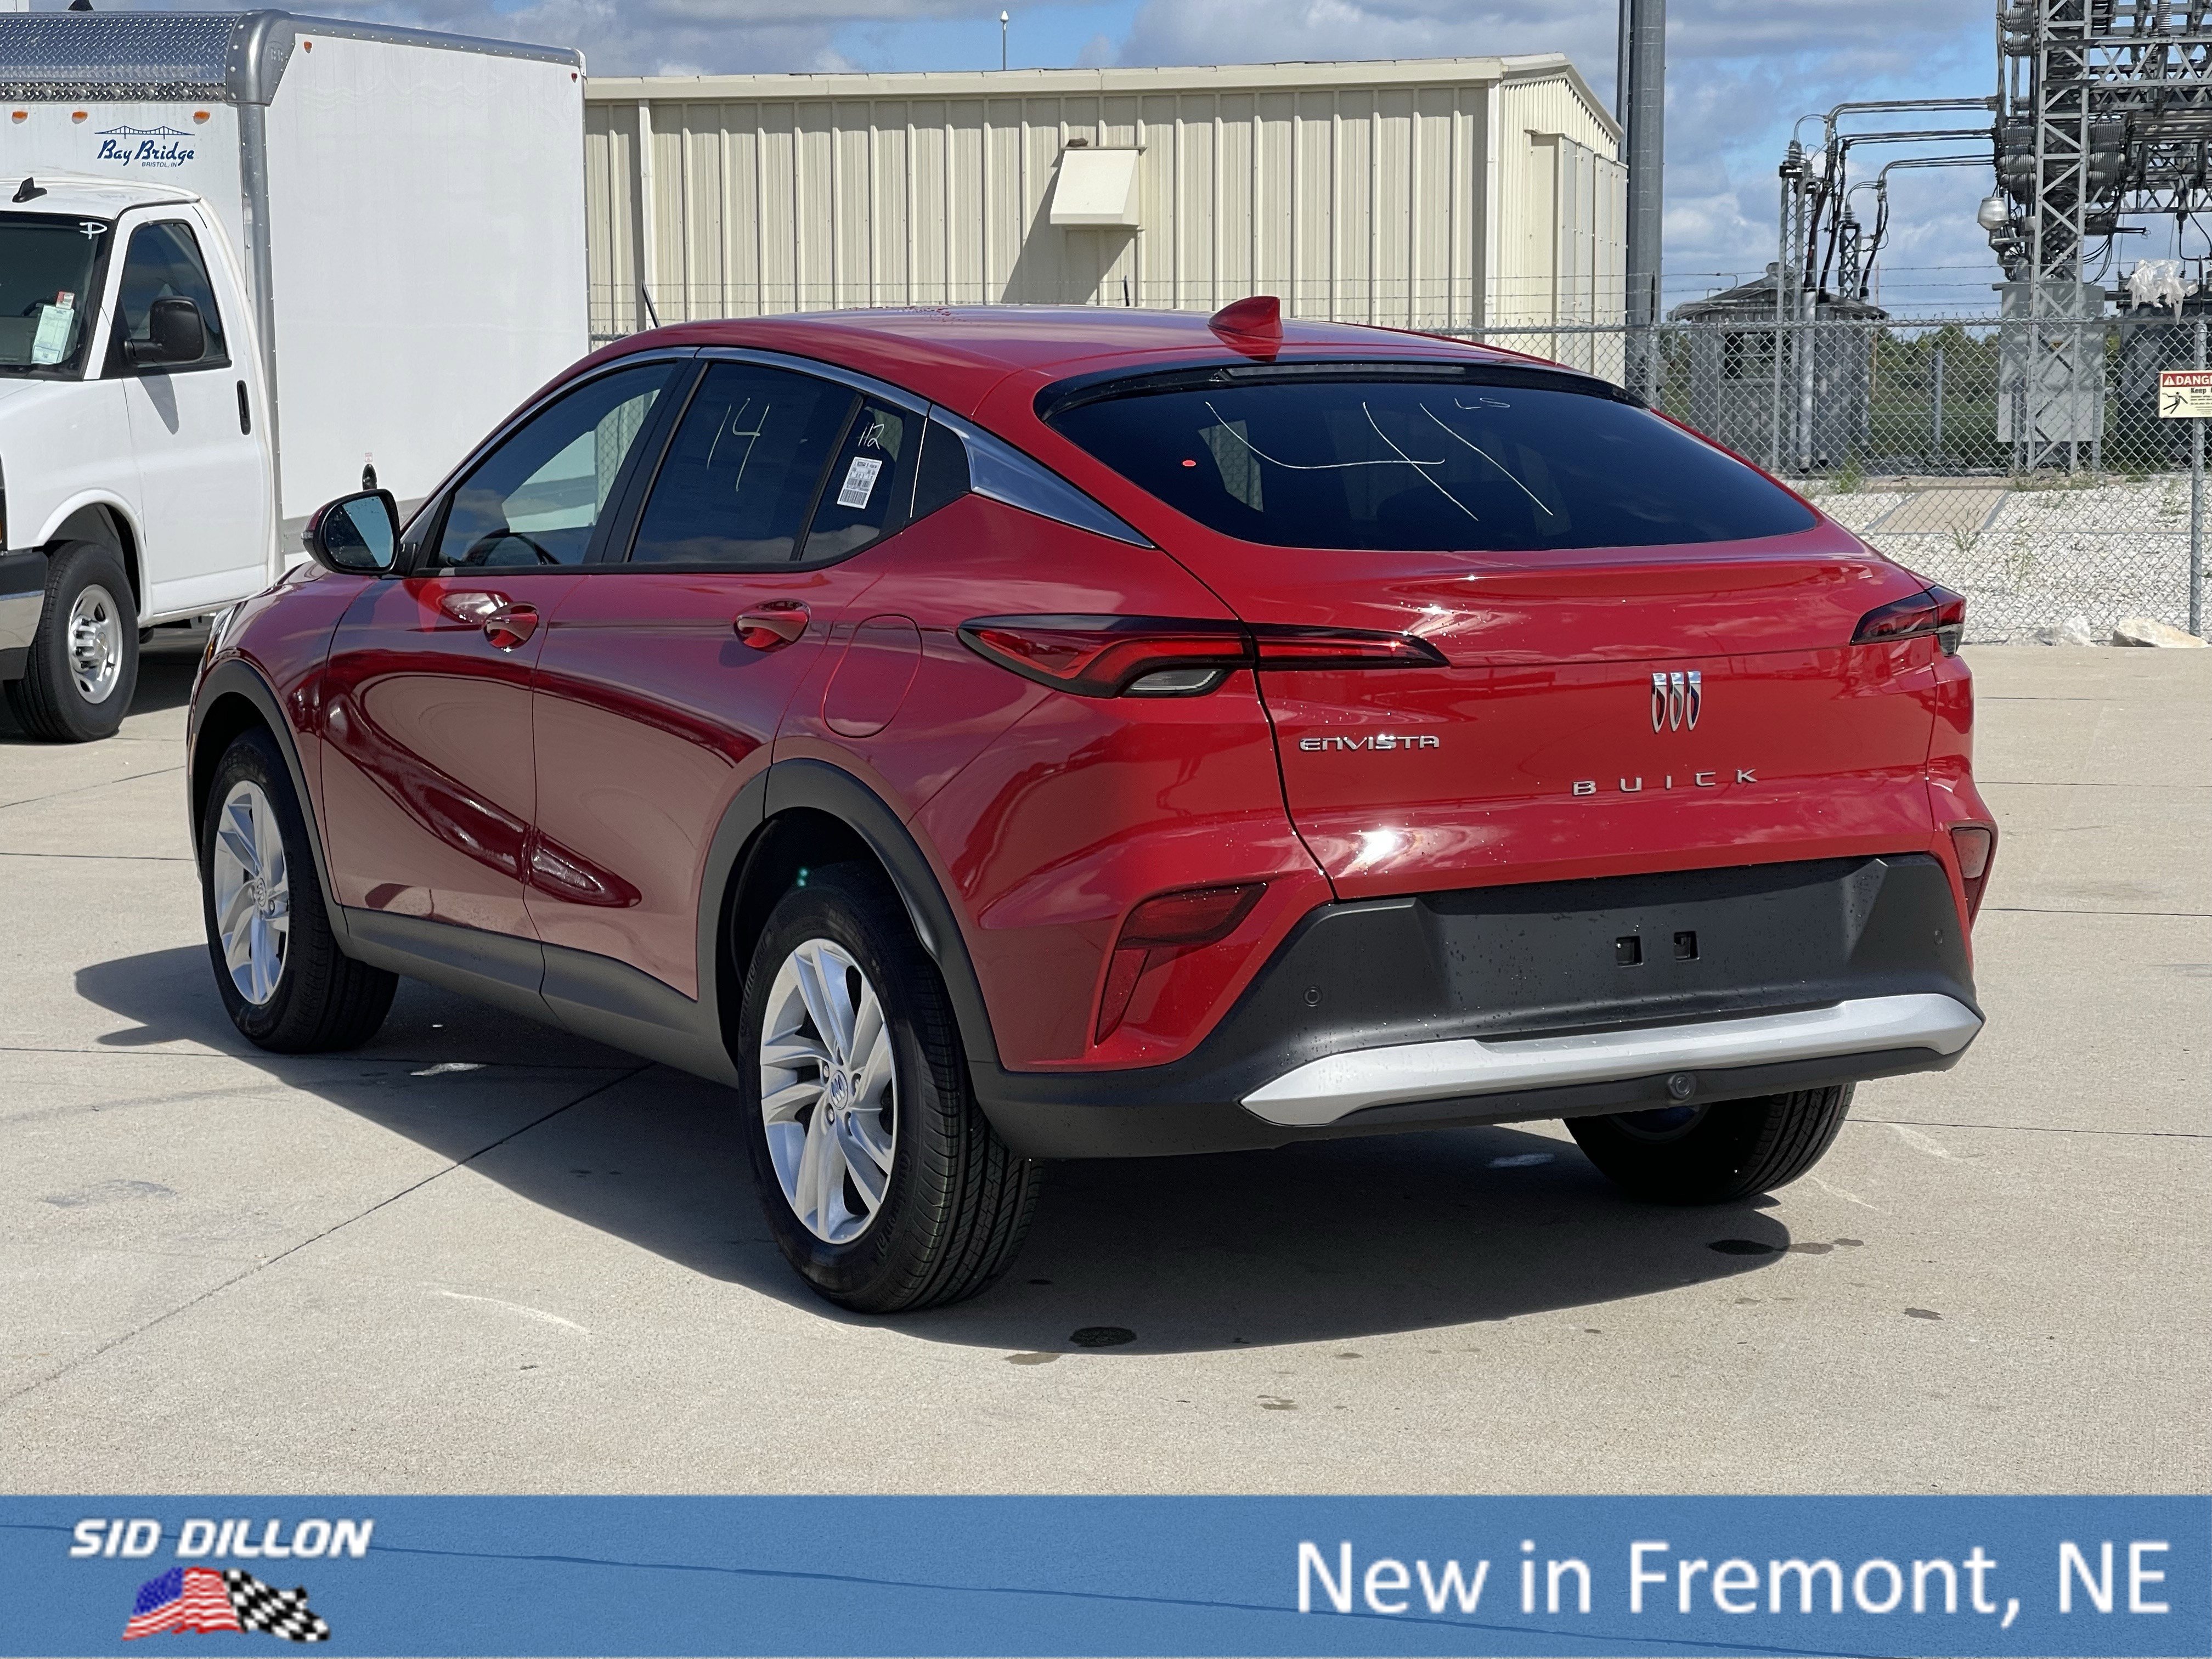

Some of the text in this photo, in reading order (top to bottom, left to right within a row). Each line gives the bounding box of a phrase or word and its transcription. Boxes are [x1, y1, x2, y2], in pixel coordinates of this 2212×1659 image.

[97, 139, 195, 167] Bay Bridge
[707, 397, 770, 492] 14
[1299, 735, 1440, 751] ENVISTA
[1572, 768, 1758, 796] BUICK
